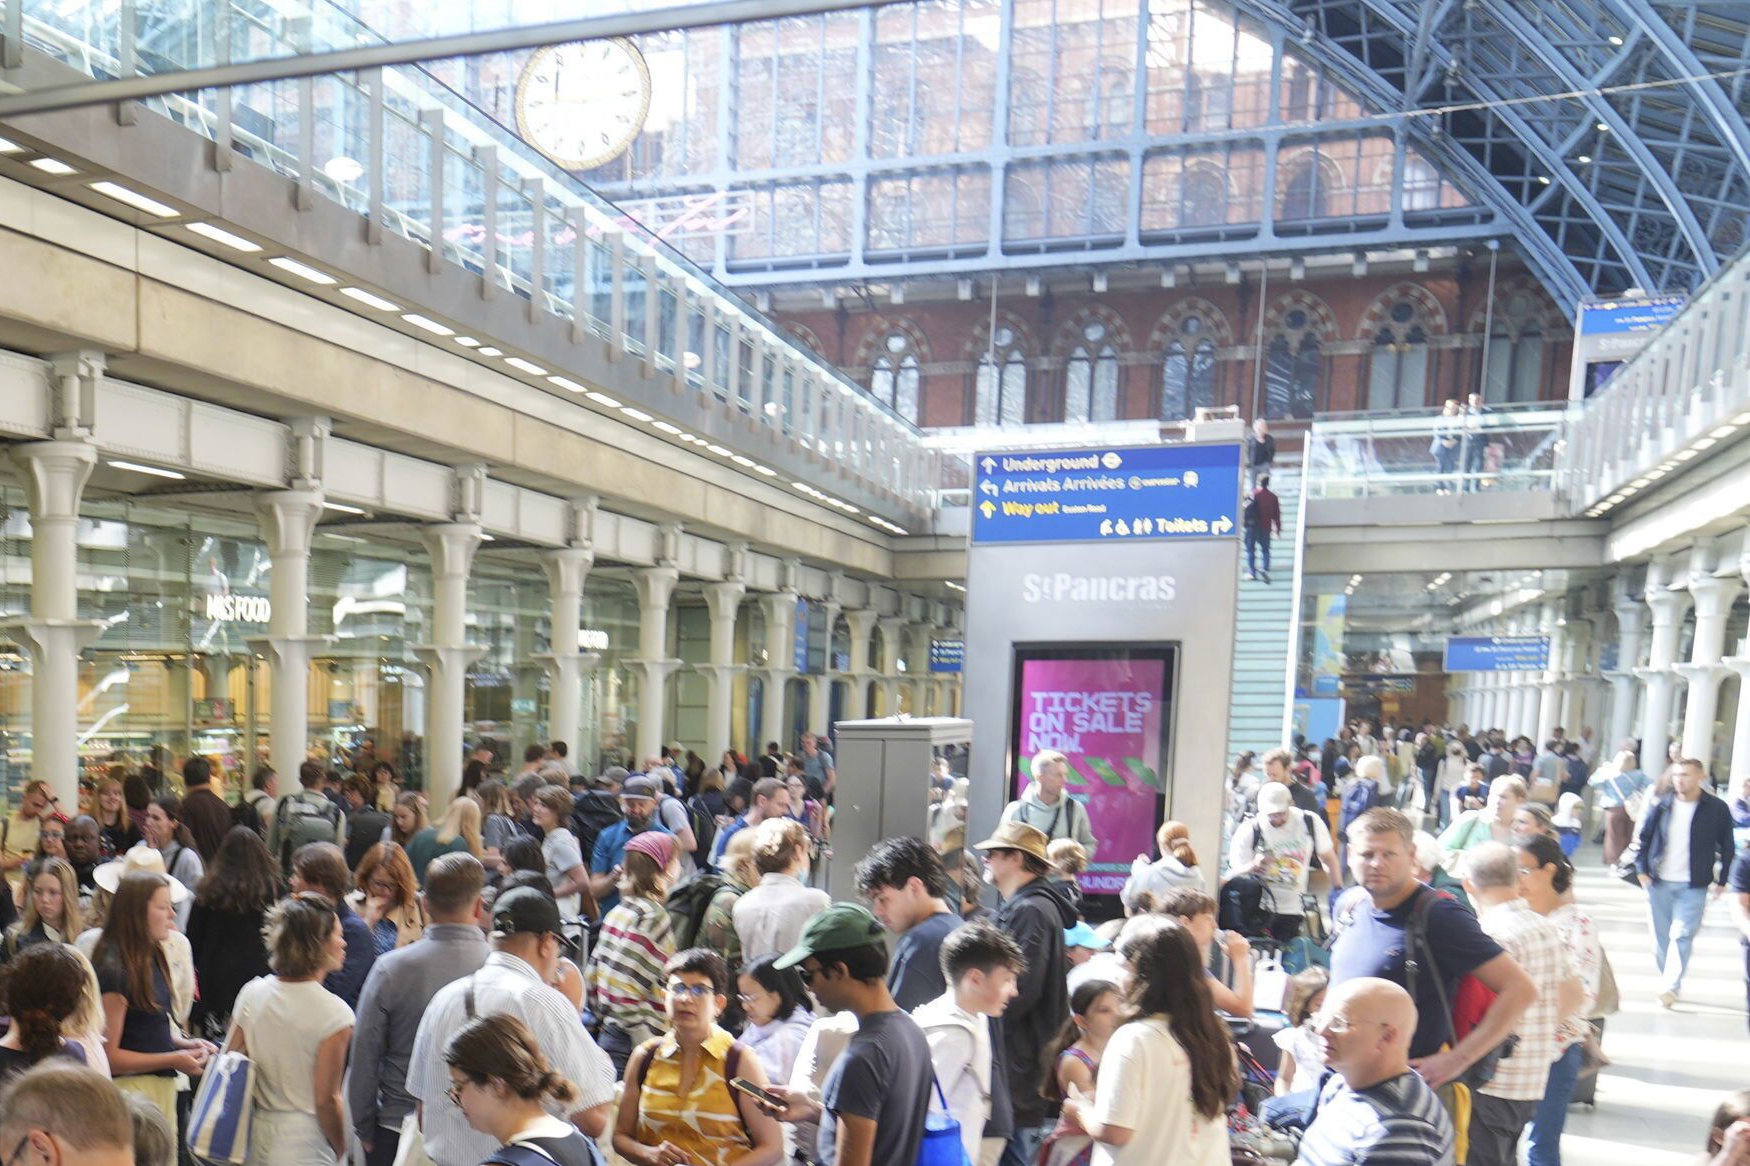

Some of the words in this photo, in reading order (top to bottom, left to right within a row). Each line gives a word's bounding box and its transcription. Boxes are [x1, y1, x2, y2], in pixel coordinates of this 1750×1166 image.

[1002, 455, 1099, 474] Underground
[1002, 476, 1061, 494] Arrivals
[1062, 475, 1126, 492] Arrivées
[1002, 501, 1034, 518] Way
[1035, 502, 1061, 515] out
[1157, 518, 1209, 533] Toilets
[1053, 572, 1177, 601] Pancras
[207, 594, 235, 621] M&S
[235, 597, 271, 622] FOOD
[1030, 691, 1153, 714] TICKETS
[1030, 712, 1065, 734] ON
[1073, 712, 1143, 734] SALE
